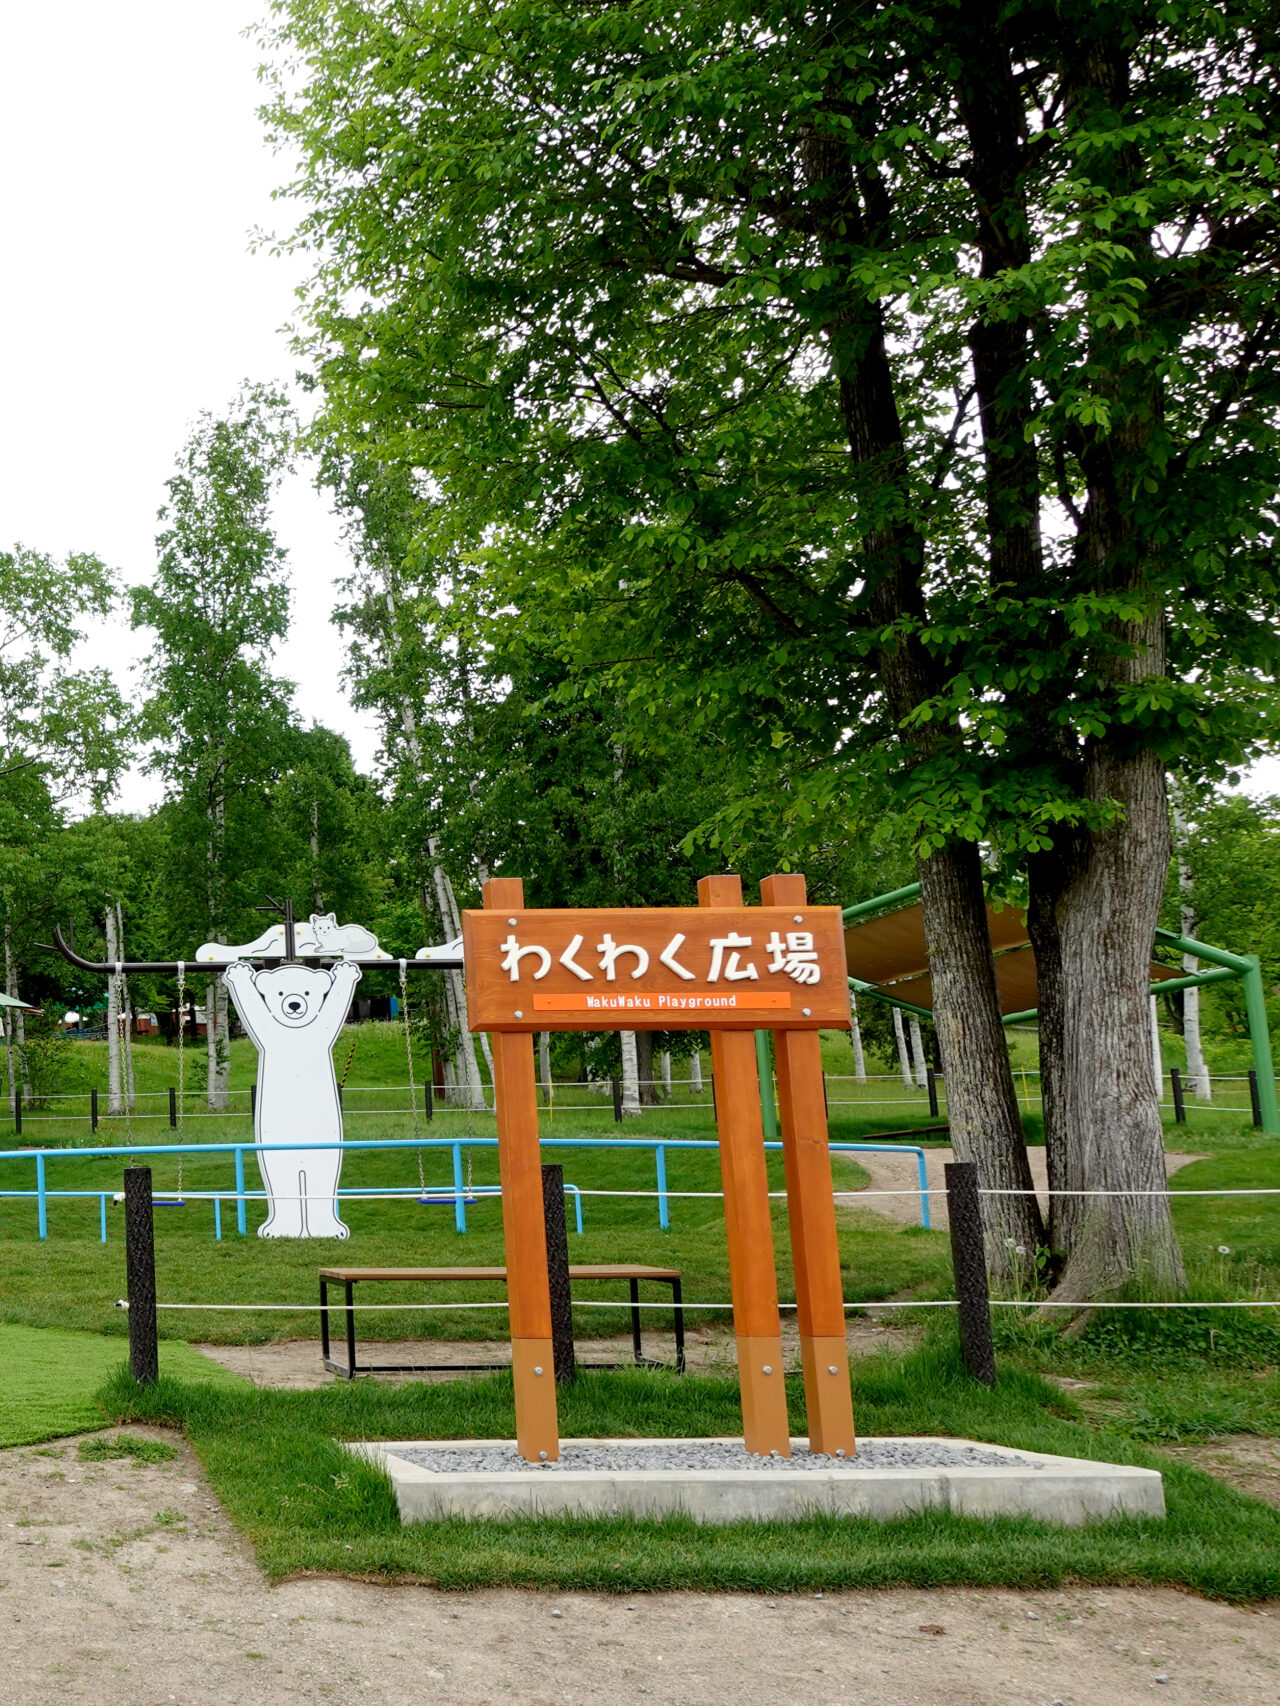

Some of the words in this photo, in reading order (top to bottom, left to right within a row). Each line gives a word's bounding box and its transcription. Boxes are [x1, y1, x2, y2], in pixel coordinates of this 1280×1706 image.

[500, 932, 821, 985] わくわく広場
[586, 995, 650, 1008] WakuWaku
[658, 994, 737, 1009] Playground
